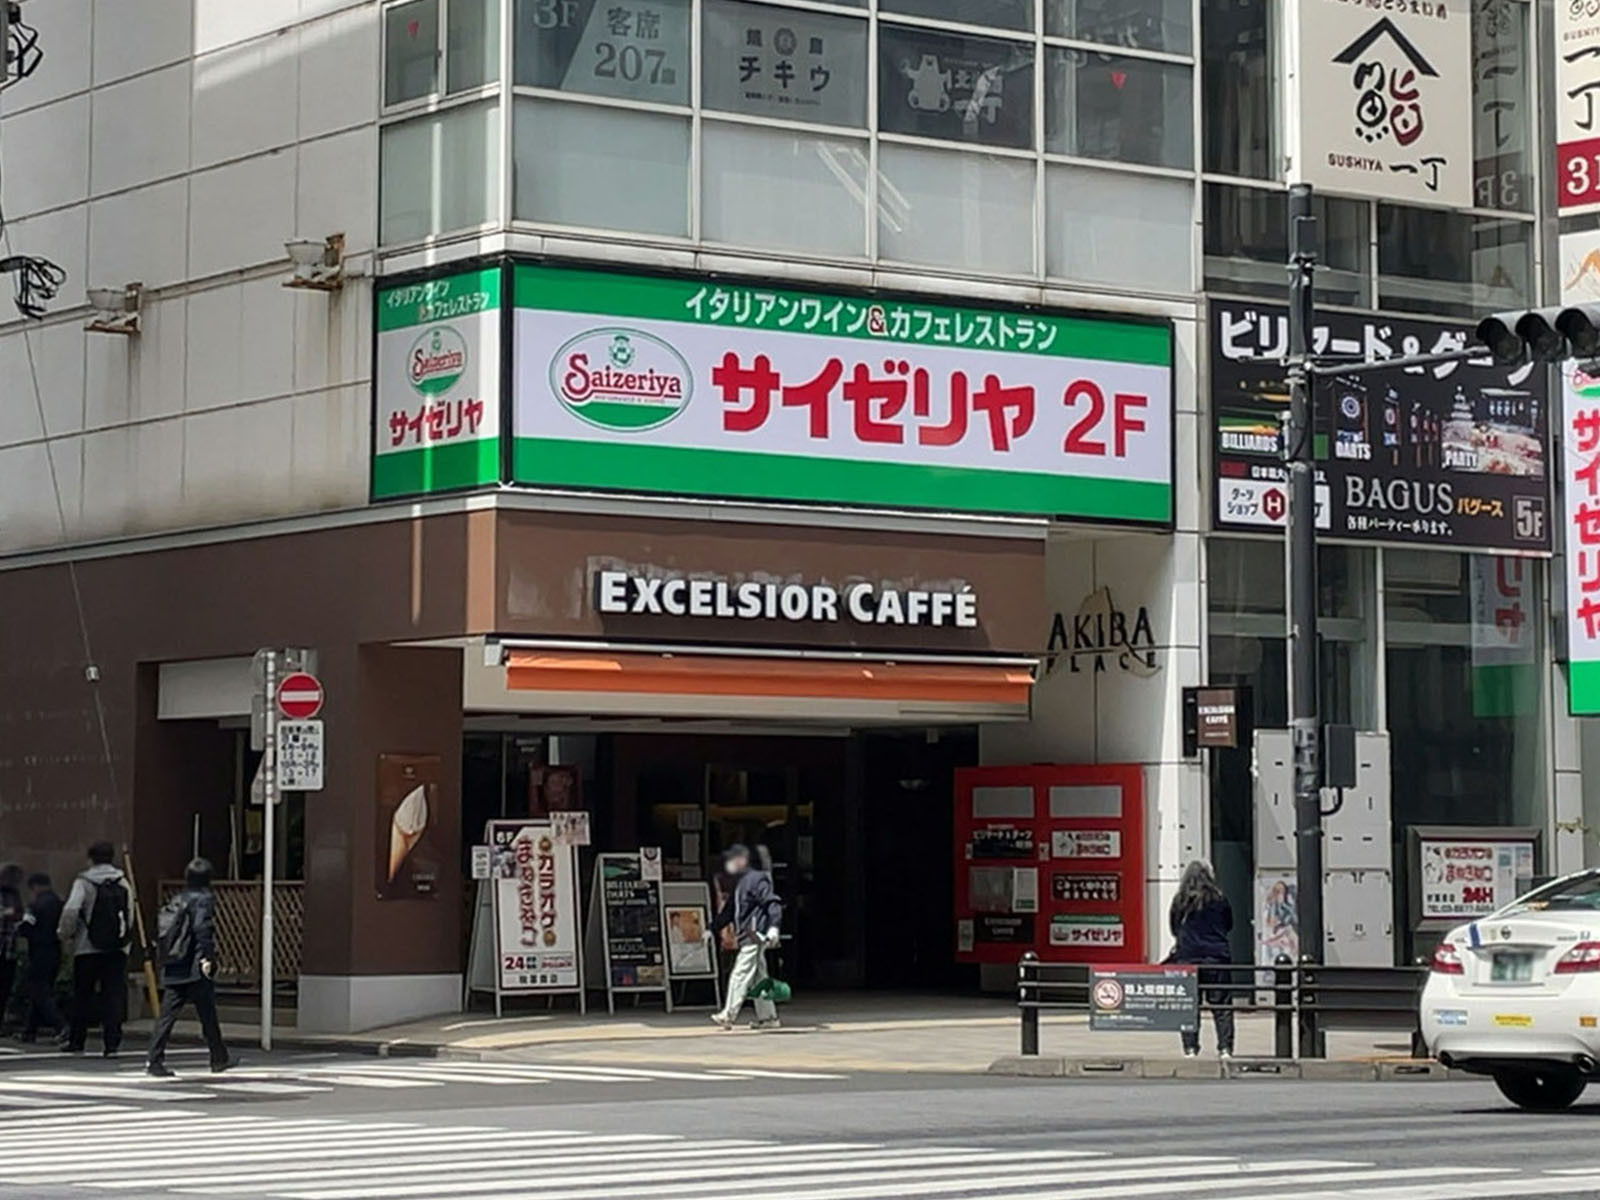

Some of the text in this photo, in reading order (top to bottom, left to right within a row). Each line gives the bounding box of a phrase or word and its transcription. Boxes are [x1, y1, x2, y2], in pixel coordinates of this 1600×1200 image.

[607, 7, 661, 39] 客席
[1328, 153, 1447, 191] SUSHIYA 一丁
[1567, 154, 1600, 196] 3
[686, 287, 1058, 351] イタリアンワイン&カフェレストラン
[562, 353, 682, 402] Saizeriya
[389, 398, 484, 446] サイゼリヤ
[711, 351, 1149, 458] サイゼリヤ 2F
[1335, 440, 1372, 460] DARTS
[1445, 449, 1480, 469] PARTY
[1345, 475, 1454, 515] BAGUS
[1457, 497, 1504, 518] バグース
[1516, 500, 1544, 538] 5F
[600, 571, 977, 628] EXCELSIOR CAFFÉ
[1047, 606, 1155, 650] AKIBA
[538, 852, 556, 930] カラオケ
[505, 956, 525, 970] 24
